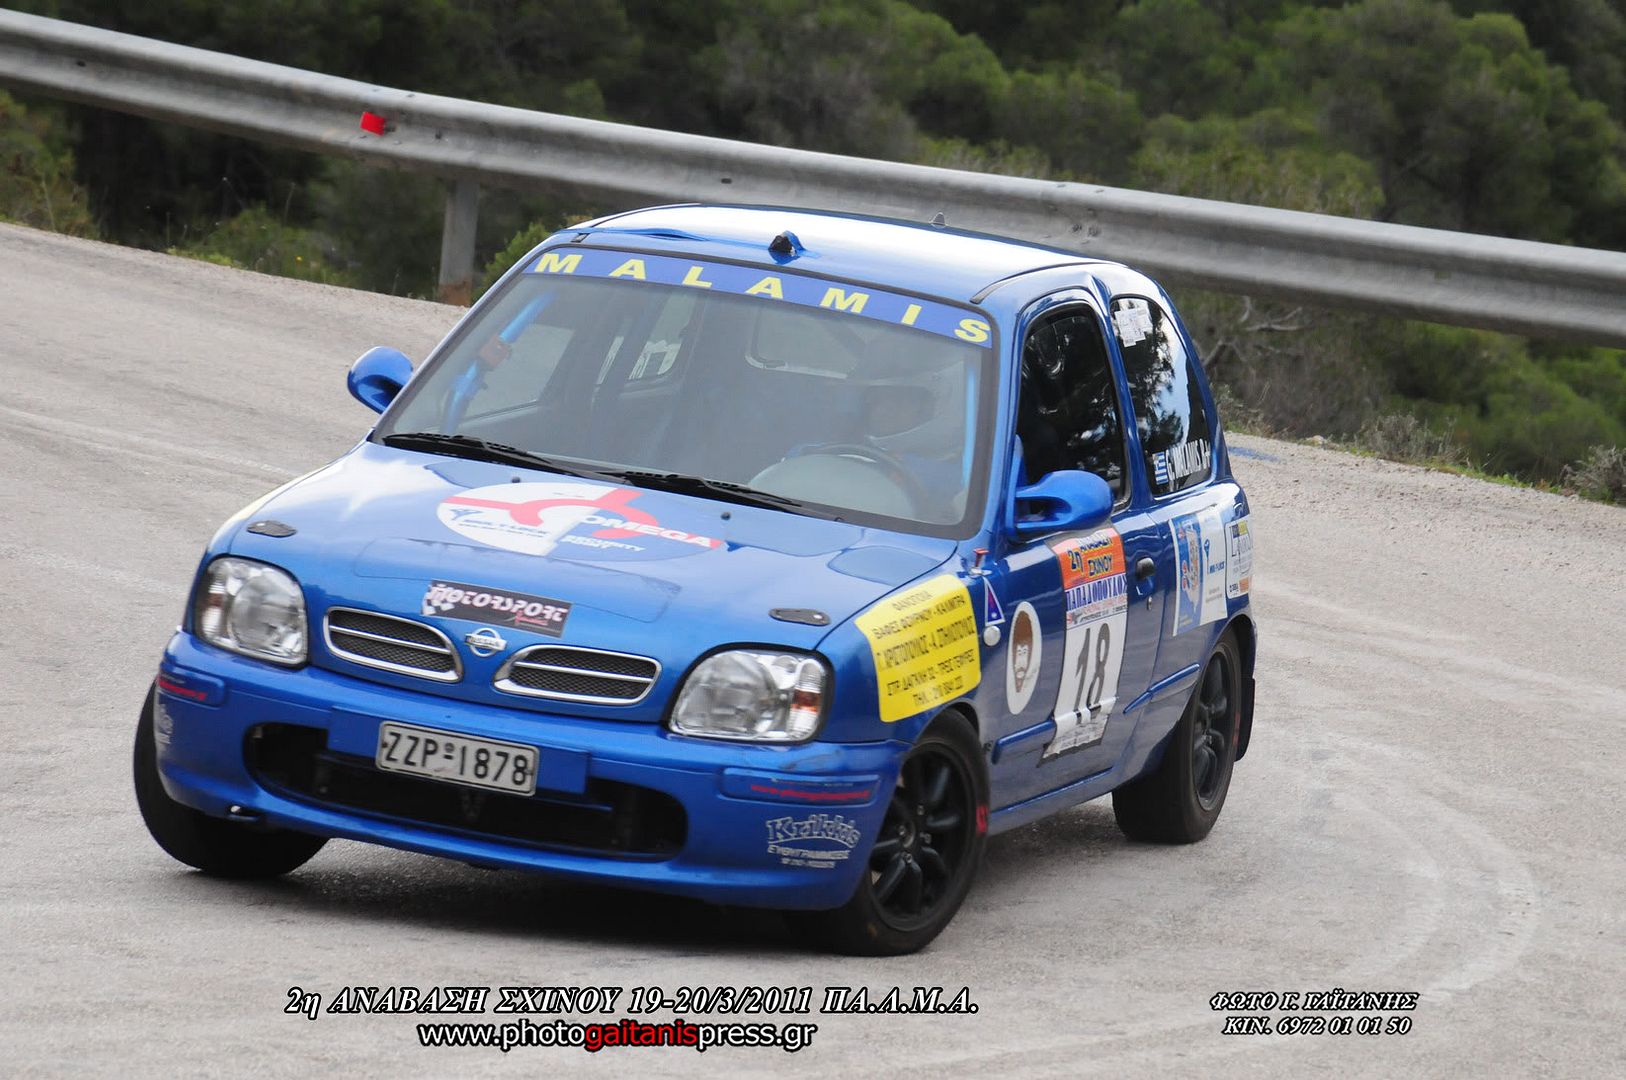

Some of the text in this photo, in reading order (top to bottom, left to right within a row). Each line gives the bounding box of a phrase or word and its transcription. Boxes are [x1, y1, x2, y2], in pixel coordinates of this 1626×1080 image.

[533, 252, 993, 344] MALAMIS
[579, 514, 715, 549] OMEGA
[1074, 622, 1110, 725] 18
